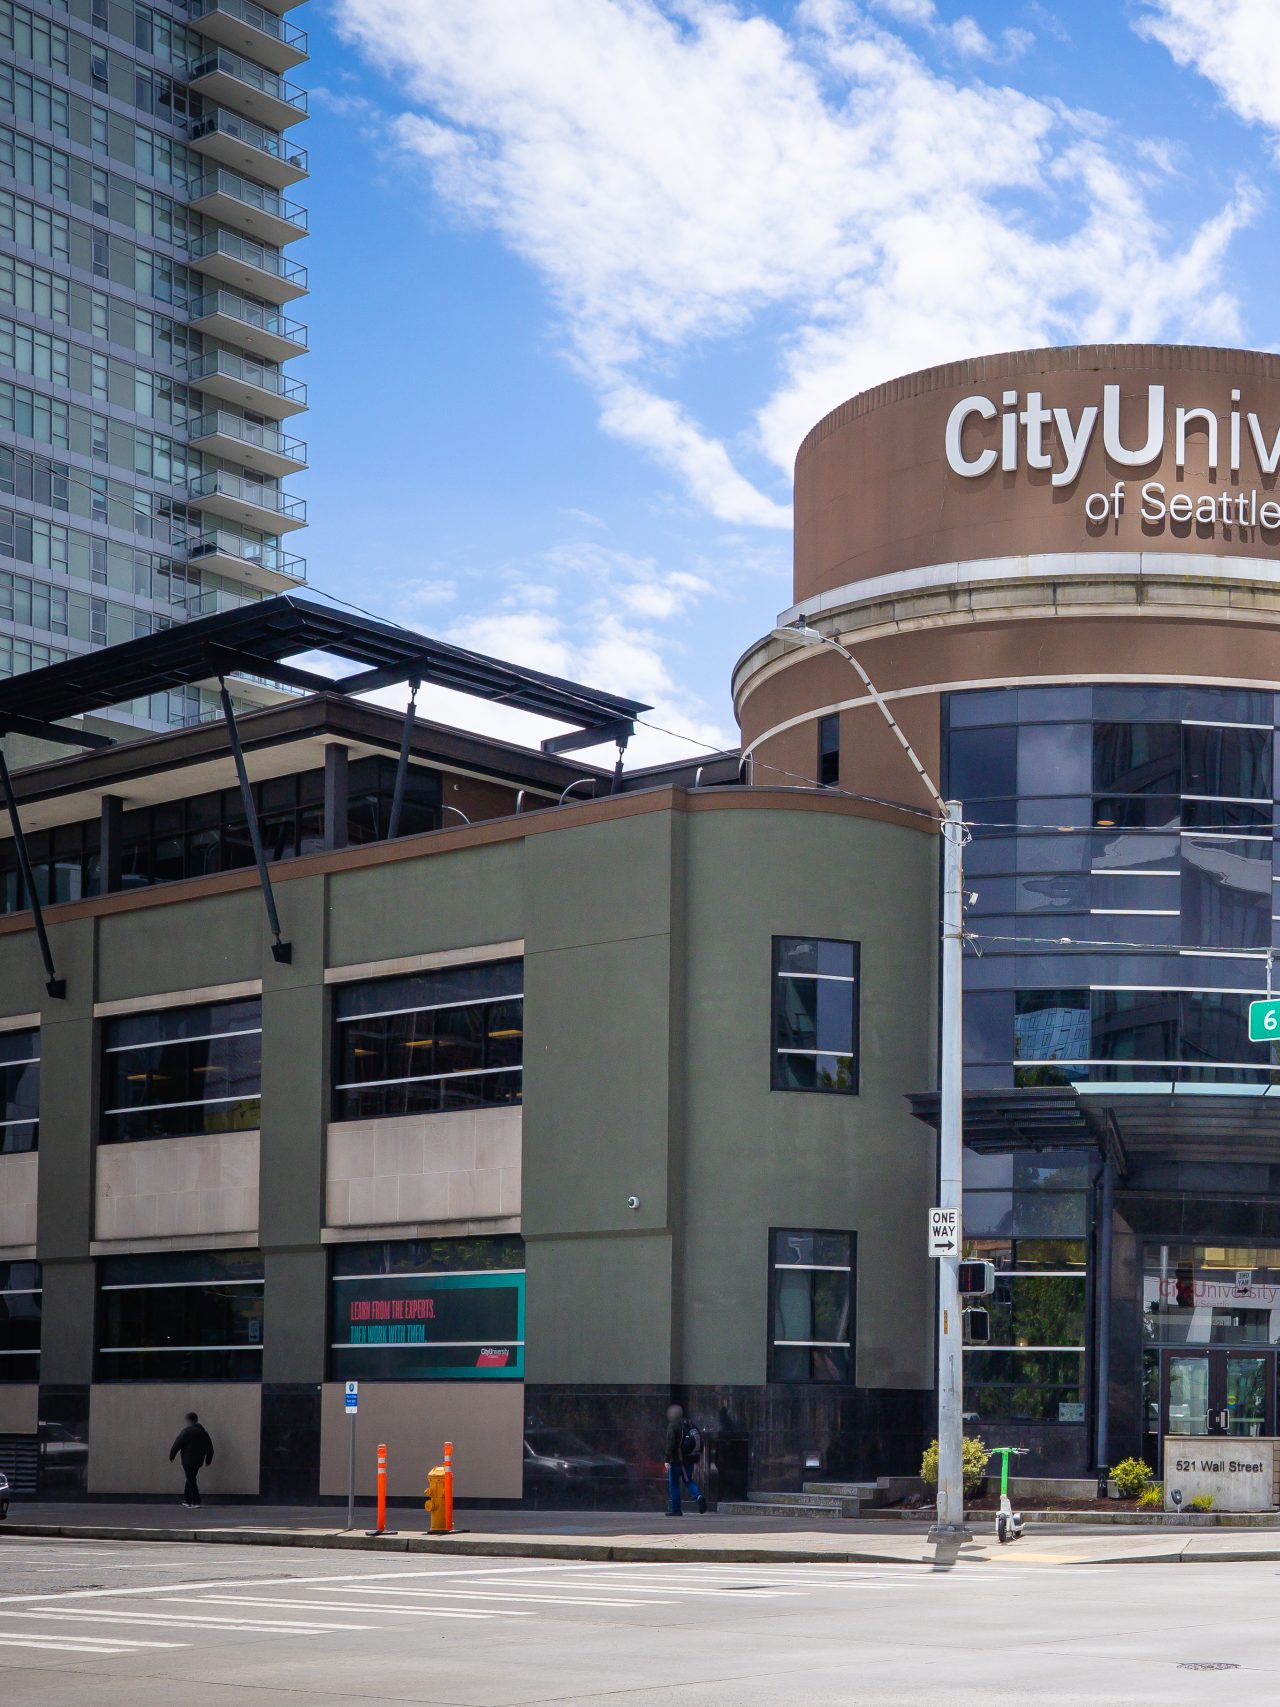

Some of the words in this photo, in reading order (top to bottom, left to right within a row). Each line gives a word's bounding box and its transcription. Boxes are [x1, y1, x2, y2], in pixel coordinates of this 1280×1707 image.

[1085, 482, 1126, 521] of
[932, 1212, 955, 1223] ONE
[932, 1226, 956, 1237] WAY
[392, 1300, 404, 1319] THE
[1175, 1461, 1197, 1472] 521
[1200, 1460, 1225, 1472] Wall
[1229, 1461, 1263, 1472] Street
